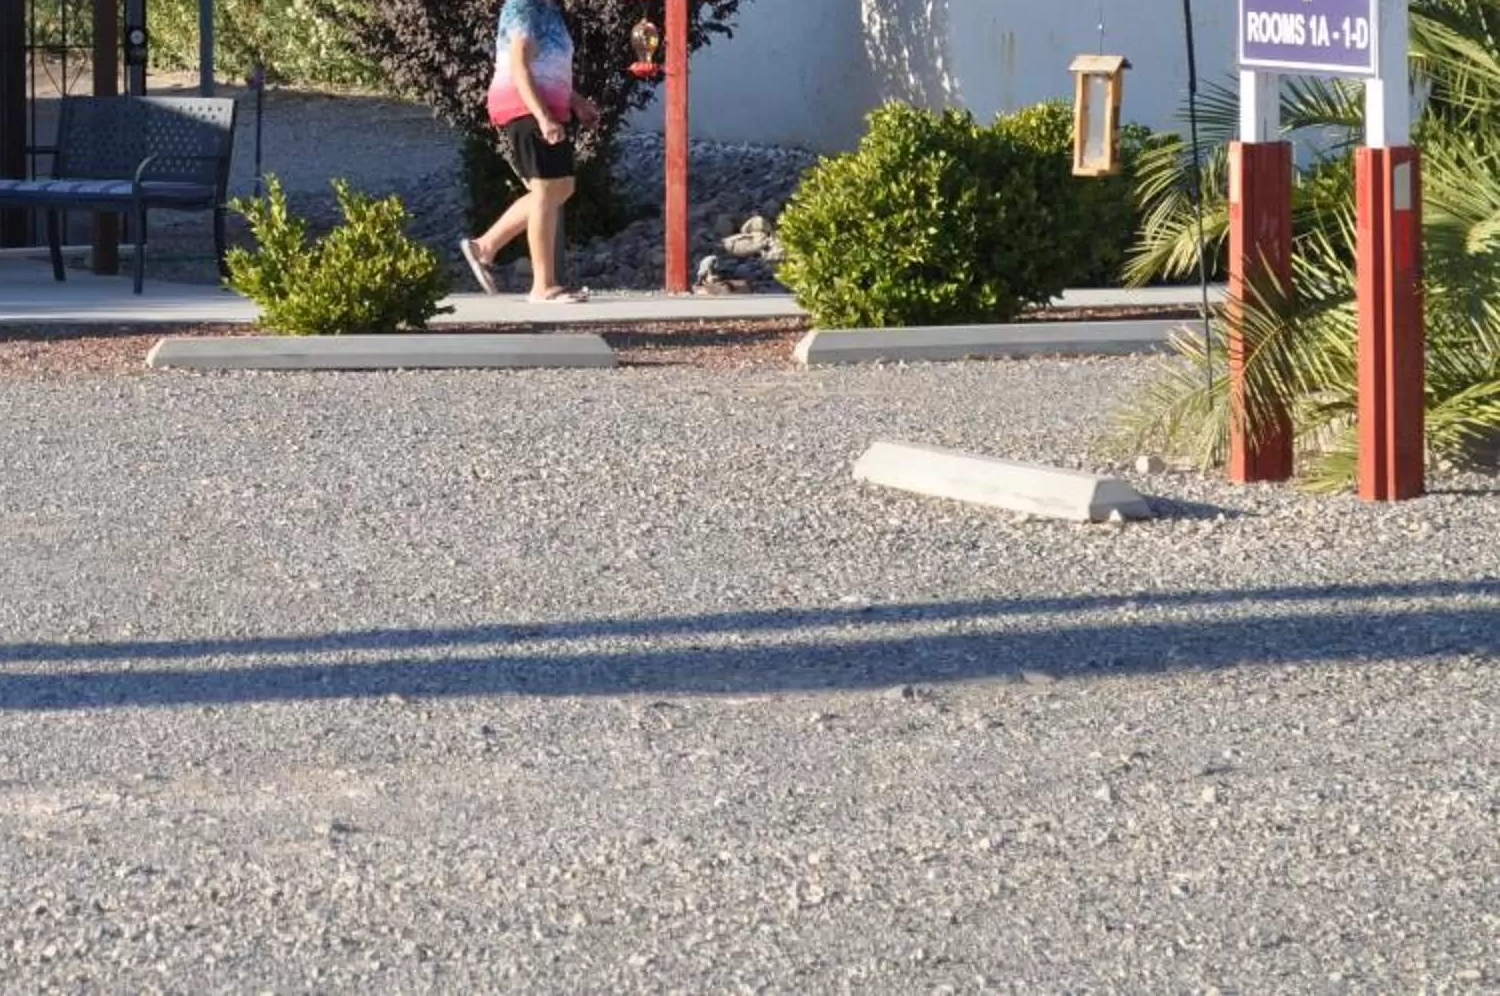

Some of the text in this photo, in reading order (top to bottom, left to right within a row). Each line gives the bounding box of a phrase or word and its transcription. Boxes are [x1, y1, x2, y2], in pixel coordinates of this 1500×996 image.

[1247, 11, 1305, 45] ROOMS
[1309, 15, 1331, 48] 1A
[1342, 17, 1369, 50] 1-D
